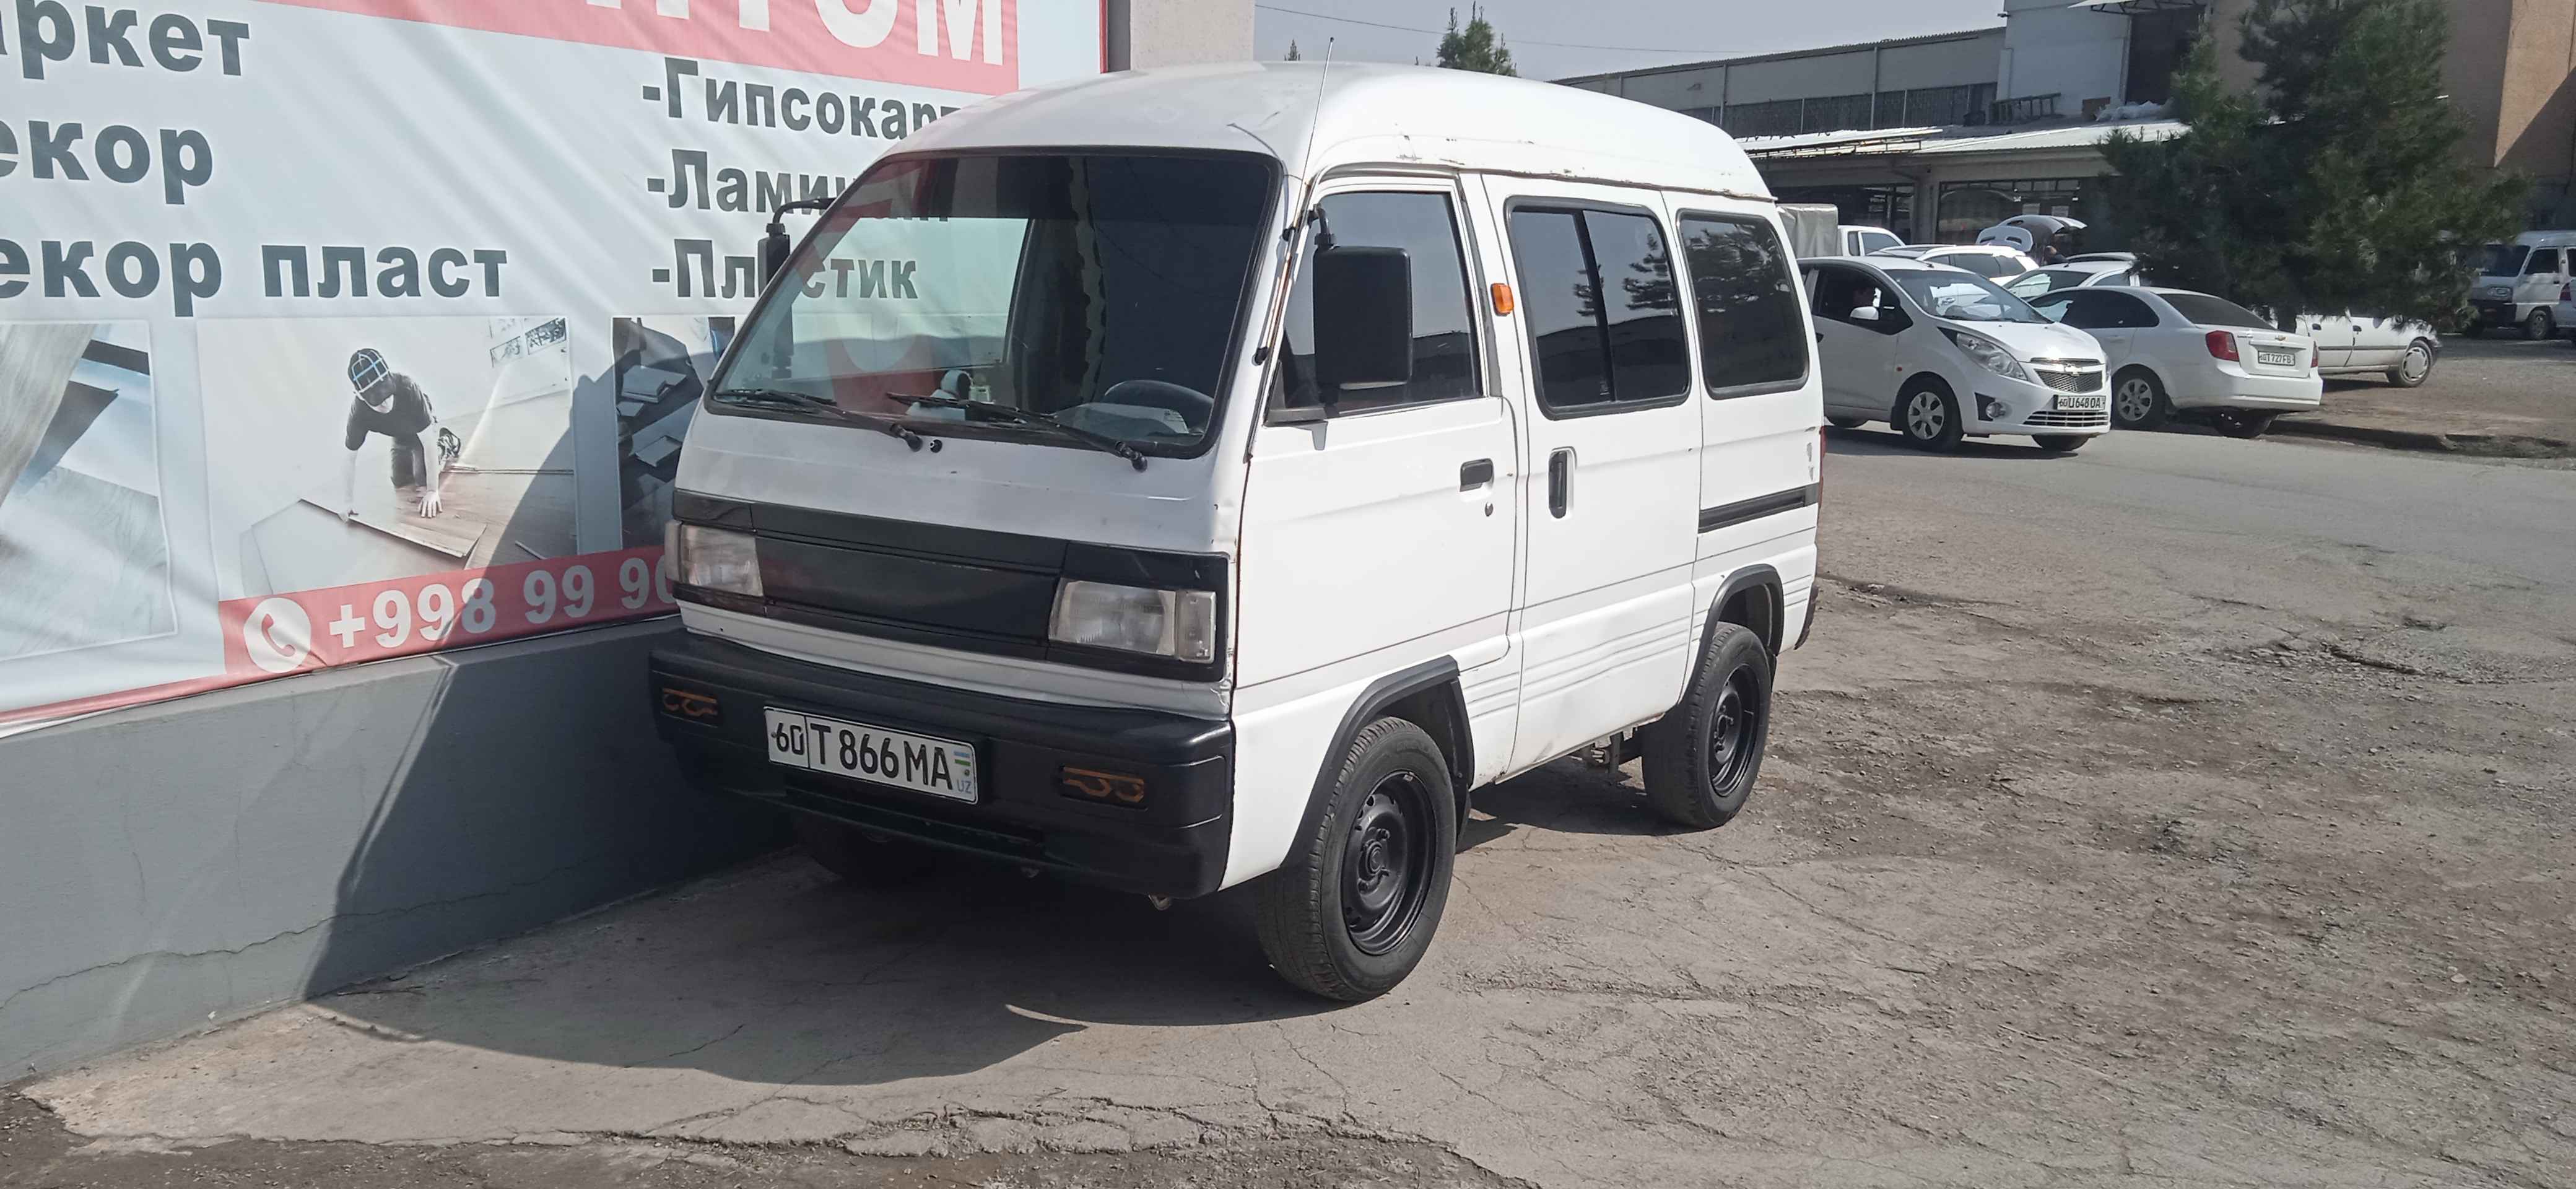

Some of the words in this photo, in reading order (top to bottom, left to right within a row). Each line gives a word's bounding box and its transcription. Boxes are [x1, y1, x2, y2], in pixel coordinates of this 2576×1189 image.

[0, 0, 250, 80] ркет
[261, 245, 508, 298] пласт
[652, 238, 919, 299] -Плстик
[329, 577, 495, 649] +998
[523, 565, 594, 624] 99
[777, 722, 804, 756] 60
[957, 780, 972, 795] UZ
